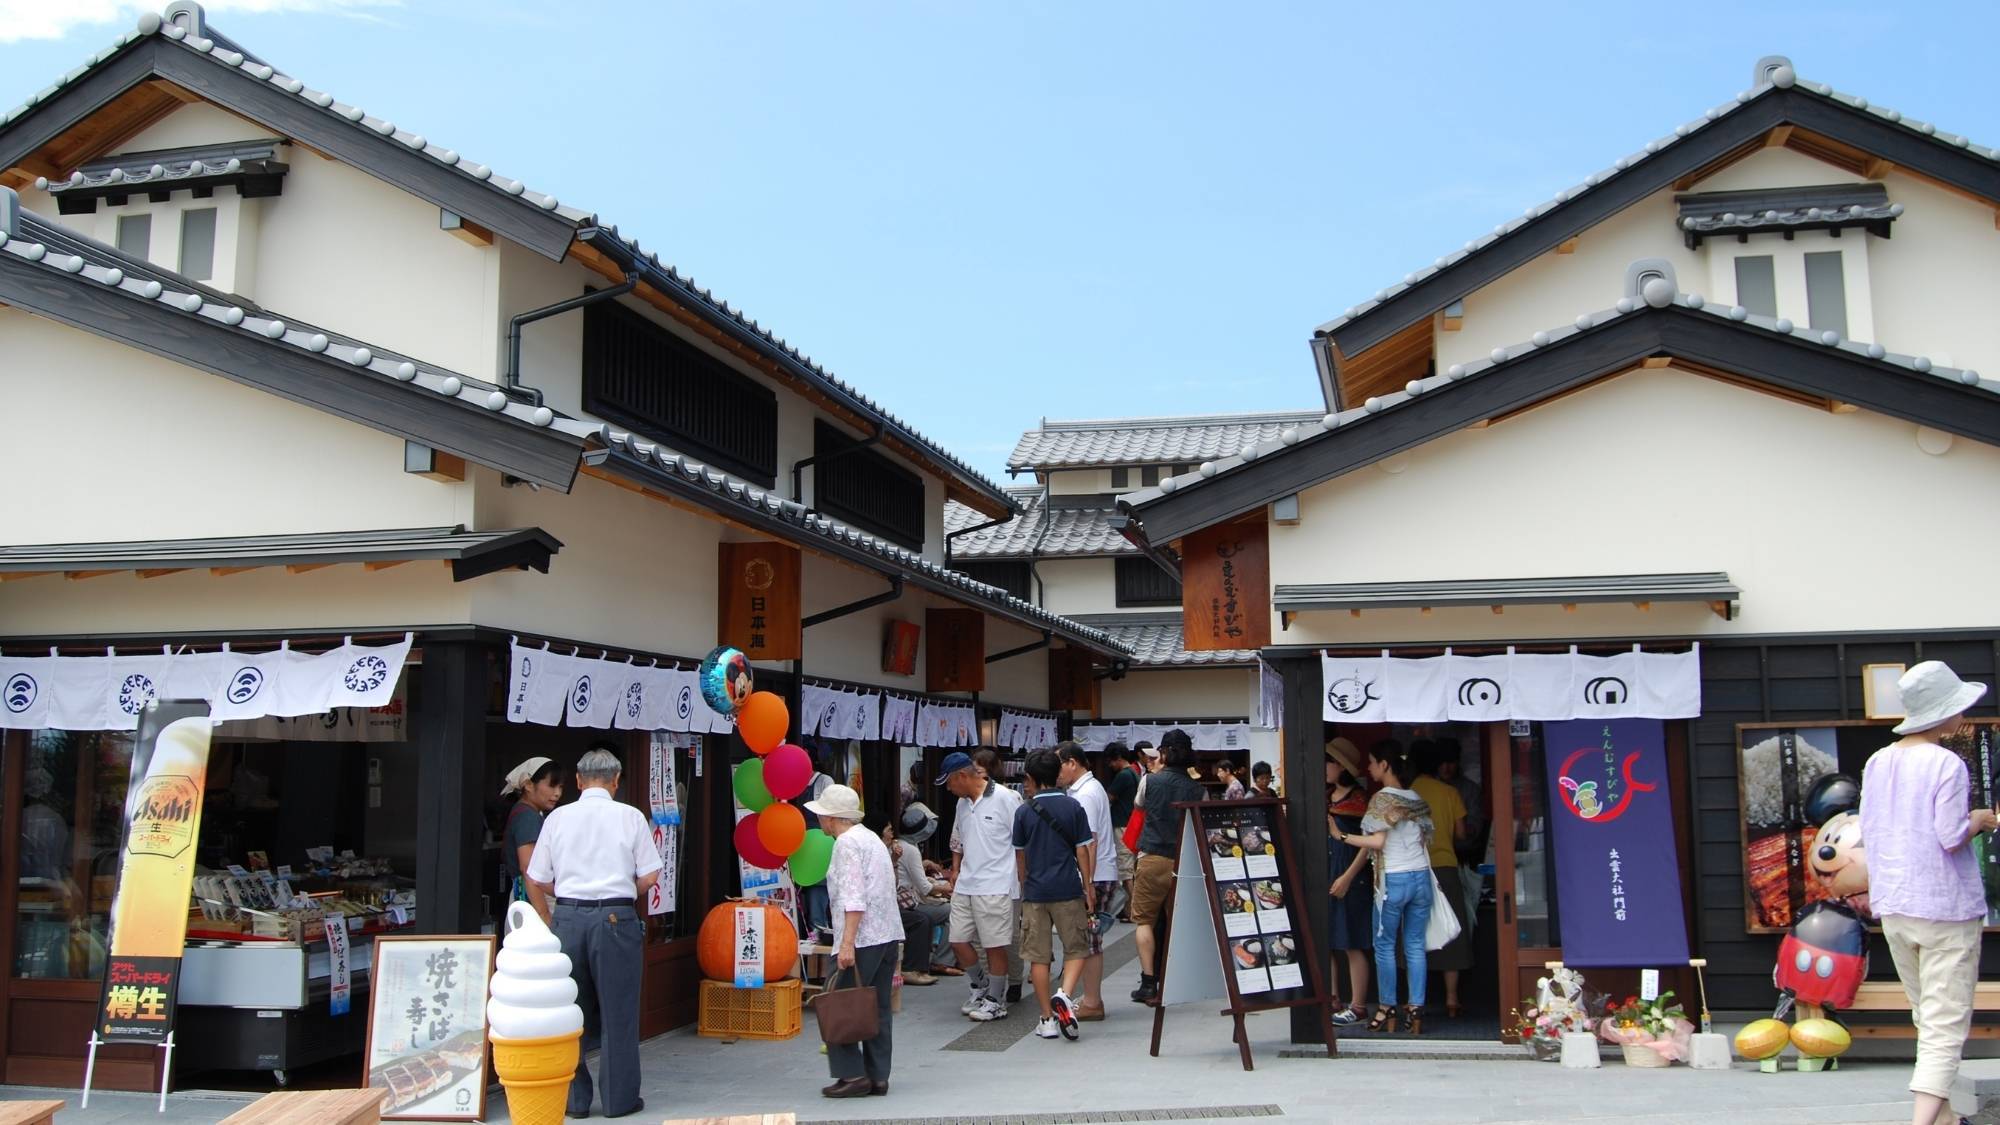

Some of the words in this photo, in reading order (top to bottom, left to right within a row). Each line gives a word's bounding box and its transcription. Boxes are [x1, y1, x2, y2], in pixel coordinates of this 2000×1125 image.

[750, 597, 765, 648] 日本海
[1602, 725, 1618, 802] えんむすびや
[1784, 739, 1793, 765] 仁多米
[133, 797, 192, 823] Asahi
[1791, 839, 1799, 867] うなぎ
[1609, 848, 1626, 920] 出雲大社門前
[111, 962, 135, 972] アサヒ
[111, 972, 171, 984] スーパードライ
[106, 985, 166, 1019] 樽生
[425, 947, 458, 1040] 焼さば
[406, 995, 427, 1049] 寿し
